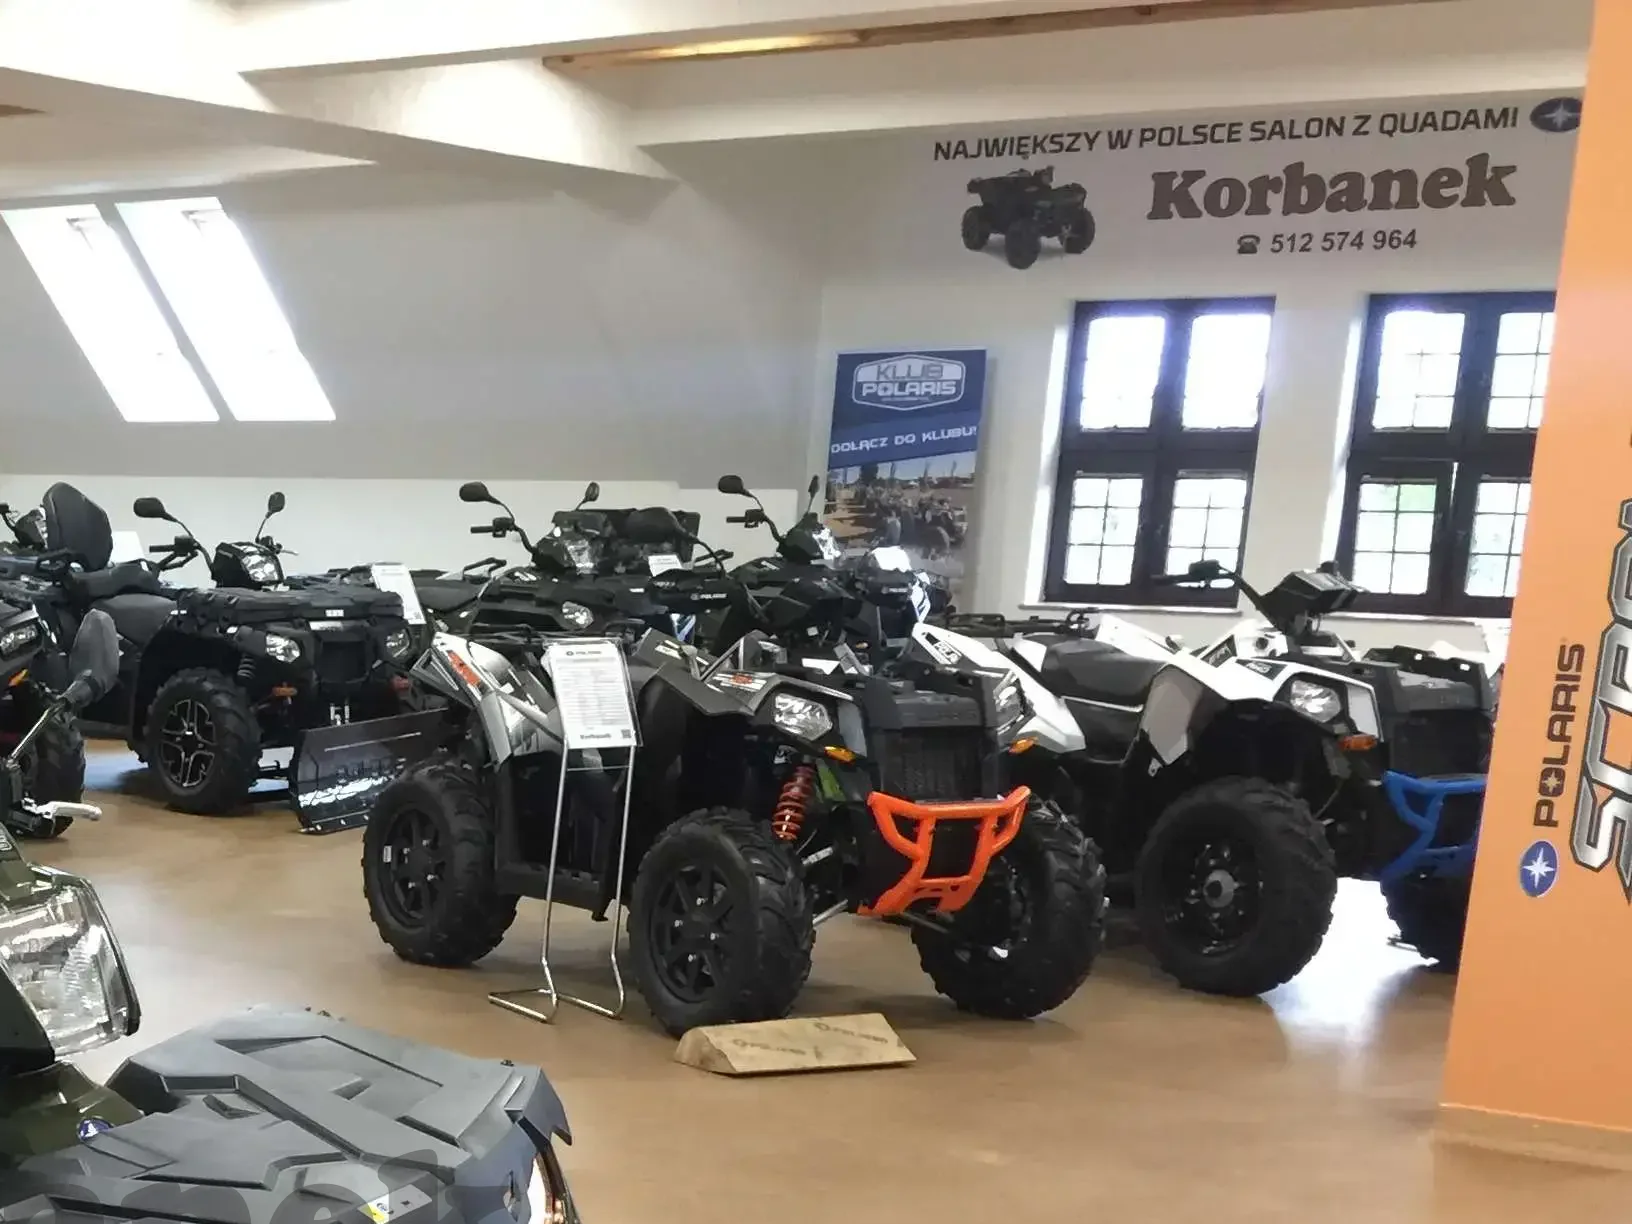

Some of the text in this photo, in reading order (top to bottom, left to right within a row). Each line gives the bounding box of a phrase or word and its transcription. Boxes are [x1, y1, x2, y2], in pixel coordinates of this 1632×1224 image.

[933, 106, 1519, 160] NAJWIĘKSZY W POLSCE SALON Z QUADAMI
[1146, 152, 1517, 220] Korbanek
[1270, 228, 1417, 253] 512 574 964
[876, 363, 944, 381] KLUB
[862, 380, 957, 397] POLARIS
[894, 433, 916, 446] DO
[922, 425, 977, 443] KLUBU!
[1533, 642, 1586, 828] POLARIS
